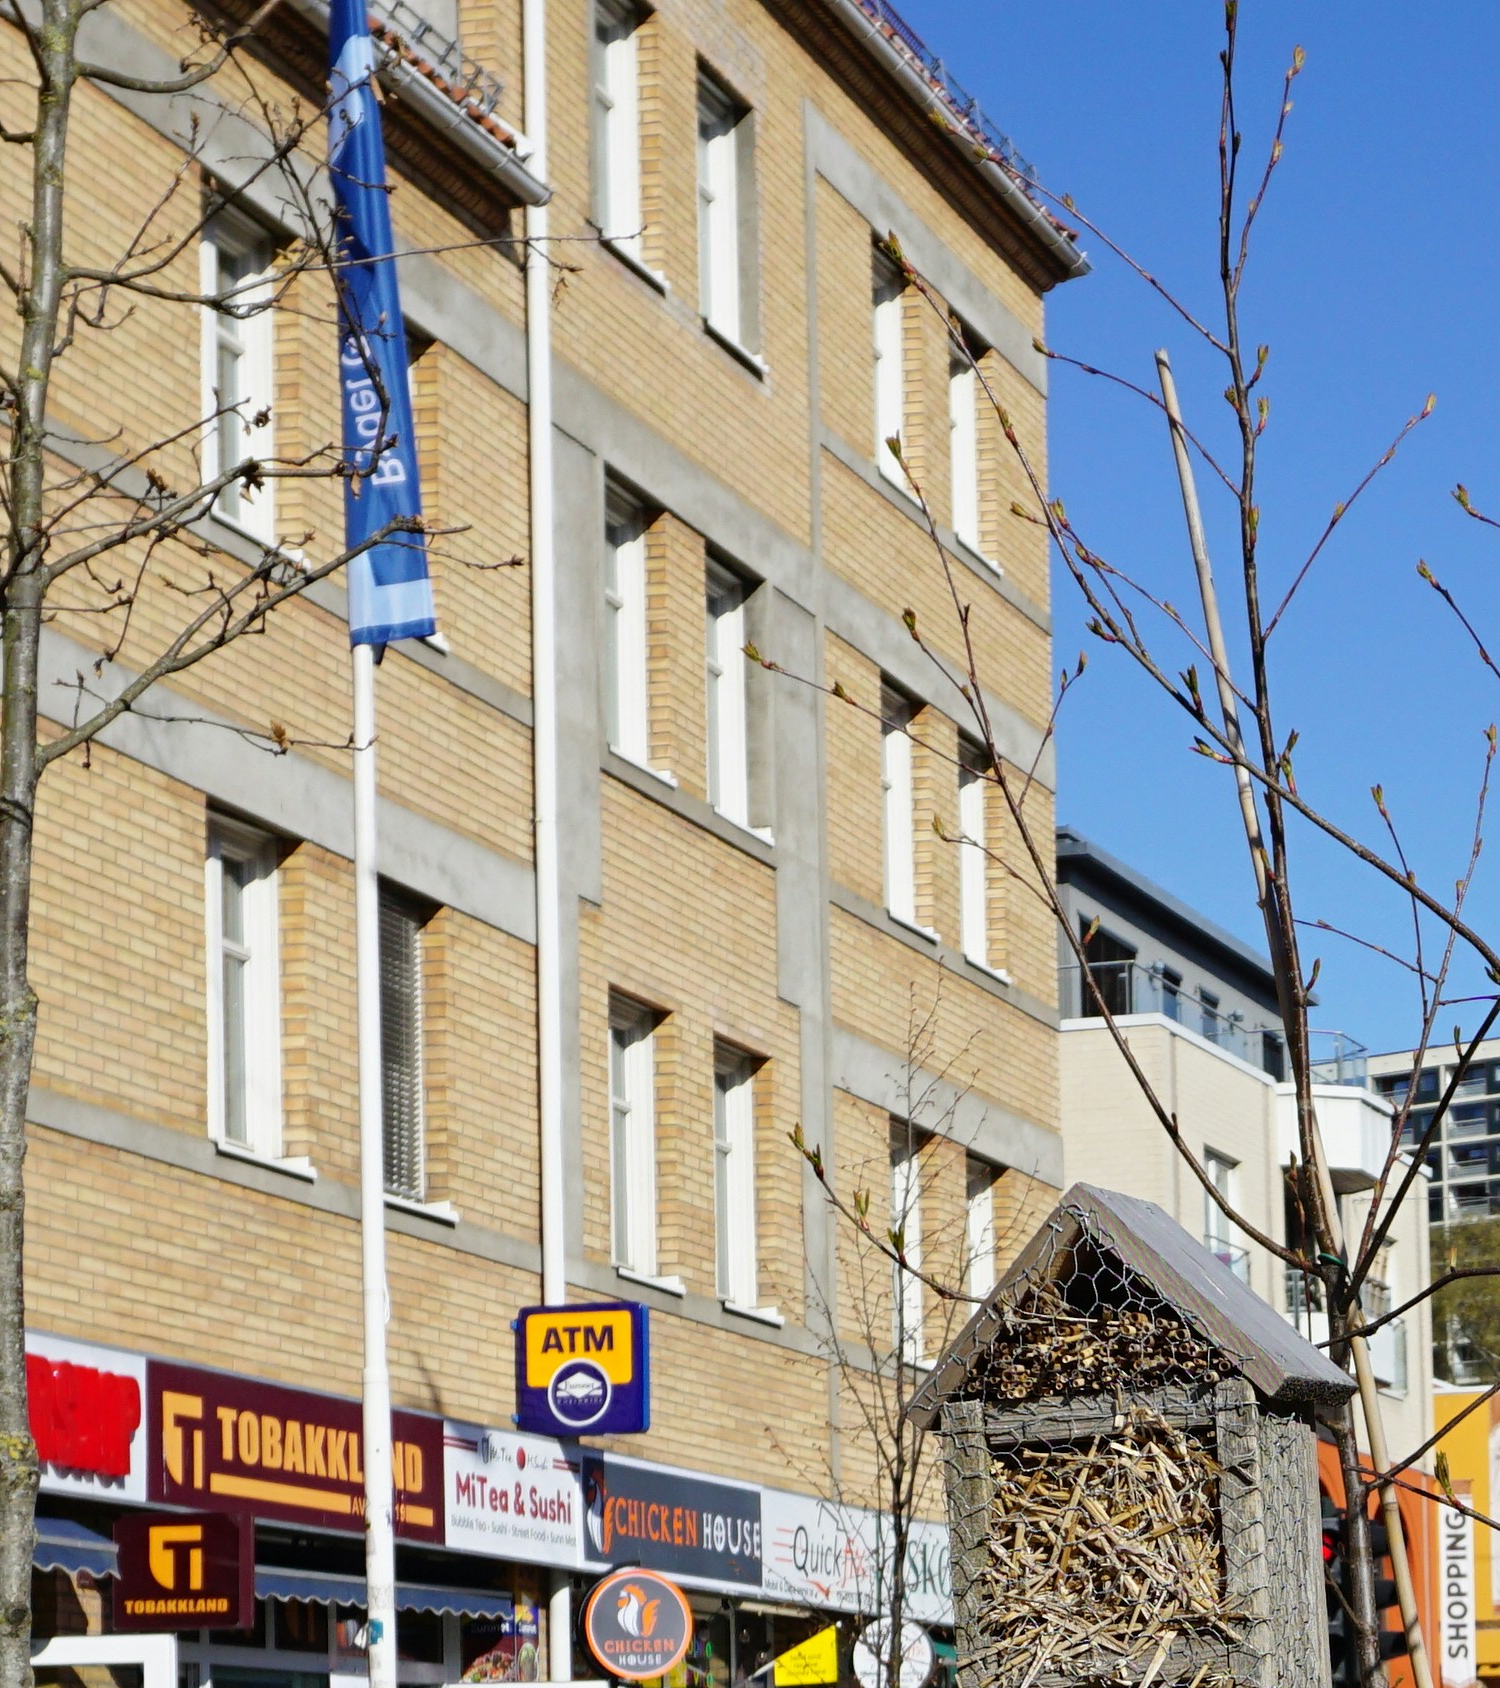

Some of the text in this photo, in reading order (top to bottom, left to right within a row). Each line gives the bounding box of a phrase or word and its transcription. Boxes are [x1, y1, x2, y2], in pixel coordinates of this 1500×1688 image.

[541, 1325, 614, 1354] ATM
[217, 1407, 423, 1493] TOBAKKLND
[514, 1481, 526, 1517] &
[529, 1485, 572, 1525] Sushi
[613, 1496, 761, 1558] CHICKEN HOUSE
[1445, 1511, 1469, 1660] SHOPPING
[124, 1598, 229, 1615] TOBAKKLAND
[604, 1638, 675, 1655] CHICKEN
[619, 1654, 662, 1666] HOUSE
